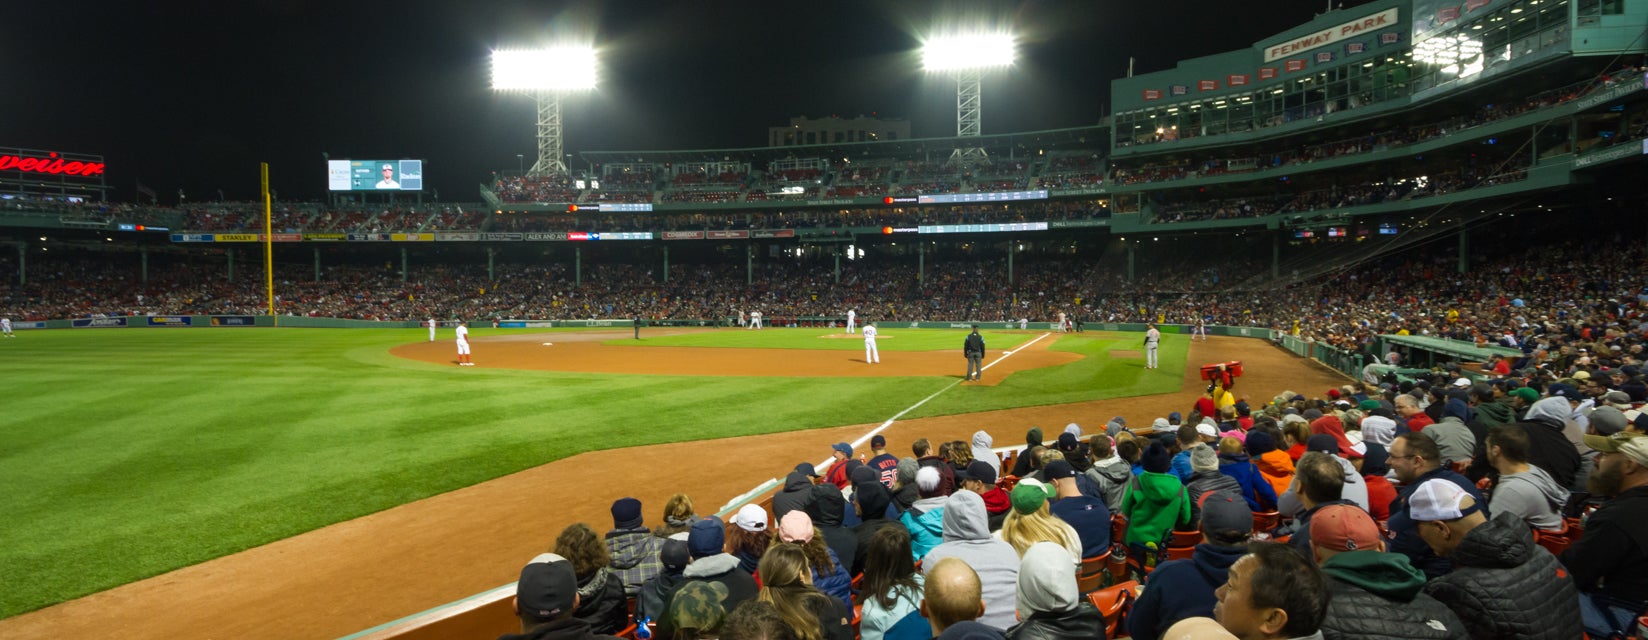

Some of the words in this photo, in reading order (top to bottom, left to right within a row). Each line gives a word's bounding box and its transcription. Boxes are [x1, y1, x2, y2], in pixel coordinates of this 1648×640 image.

[1271, 31, 1332, 58] FENWAY
[1341, 13, 1386, 36] PARK
[878, 459, 897, 470] BETTS
